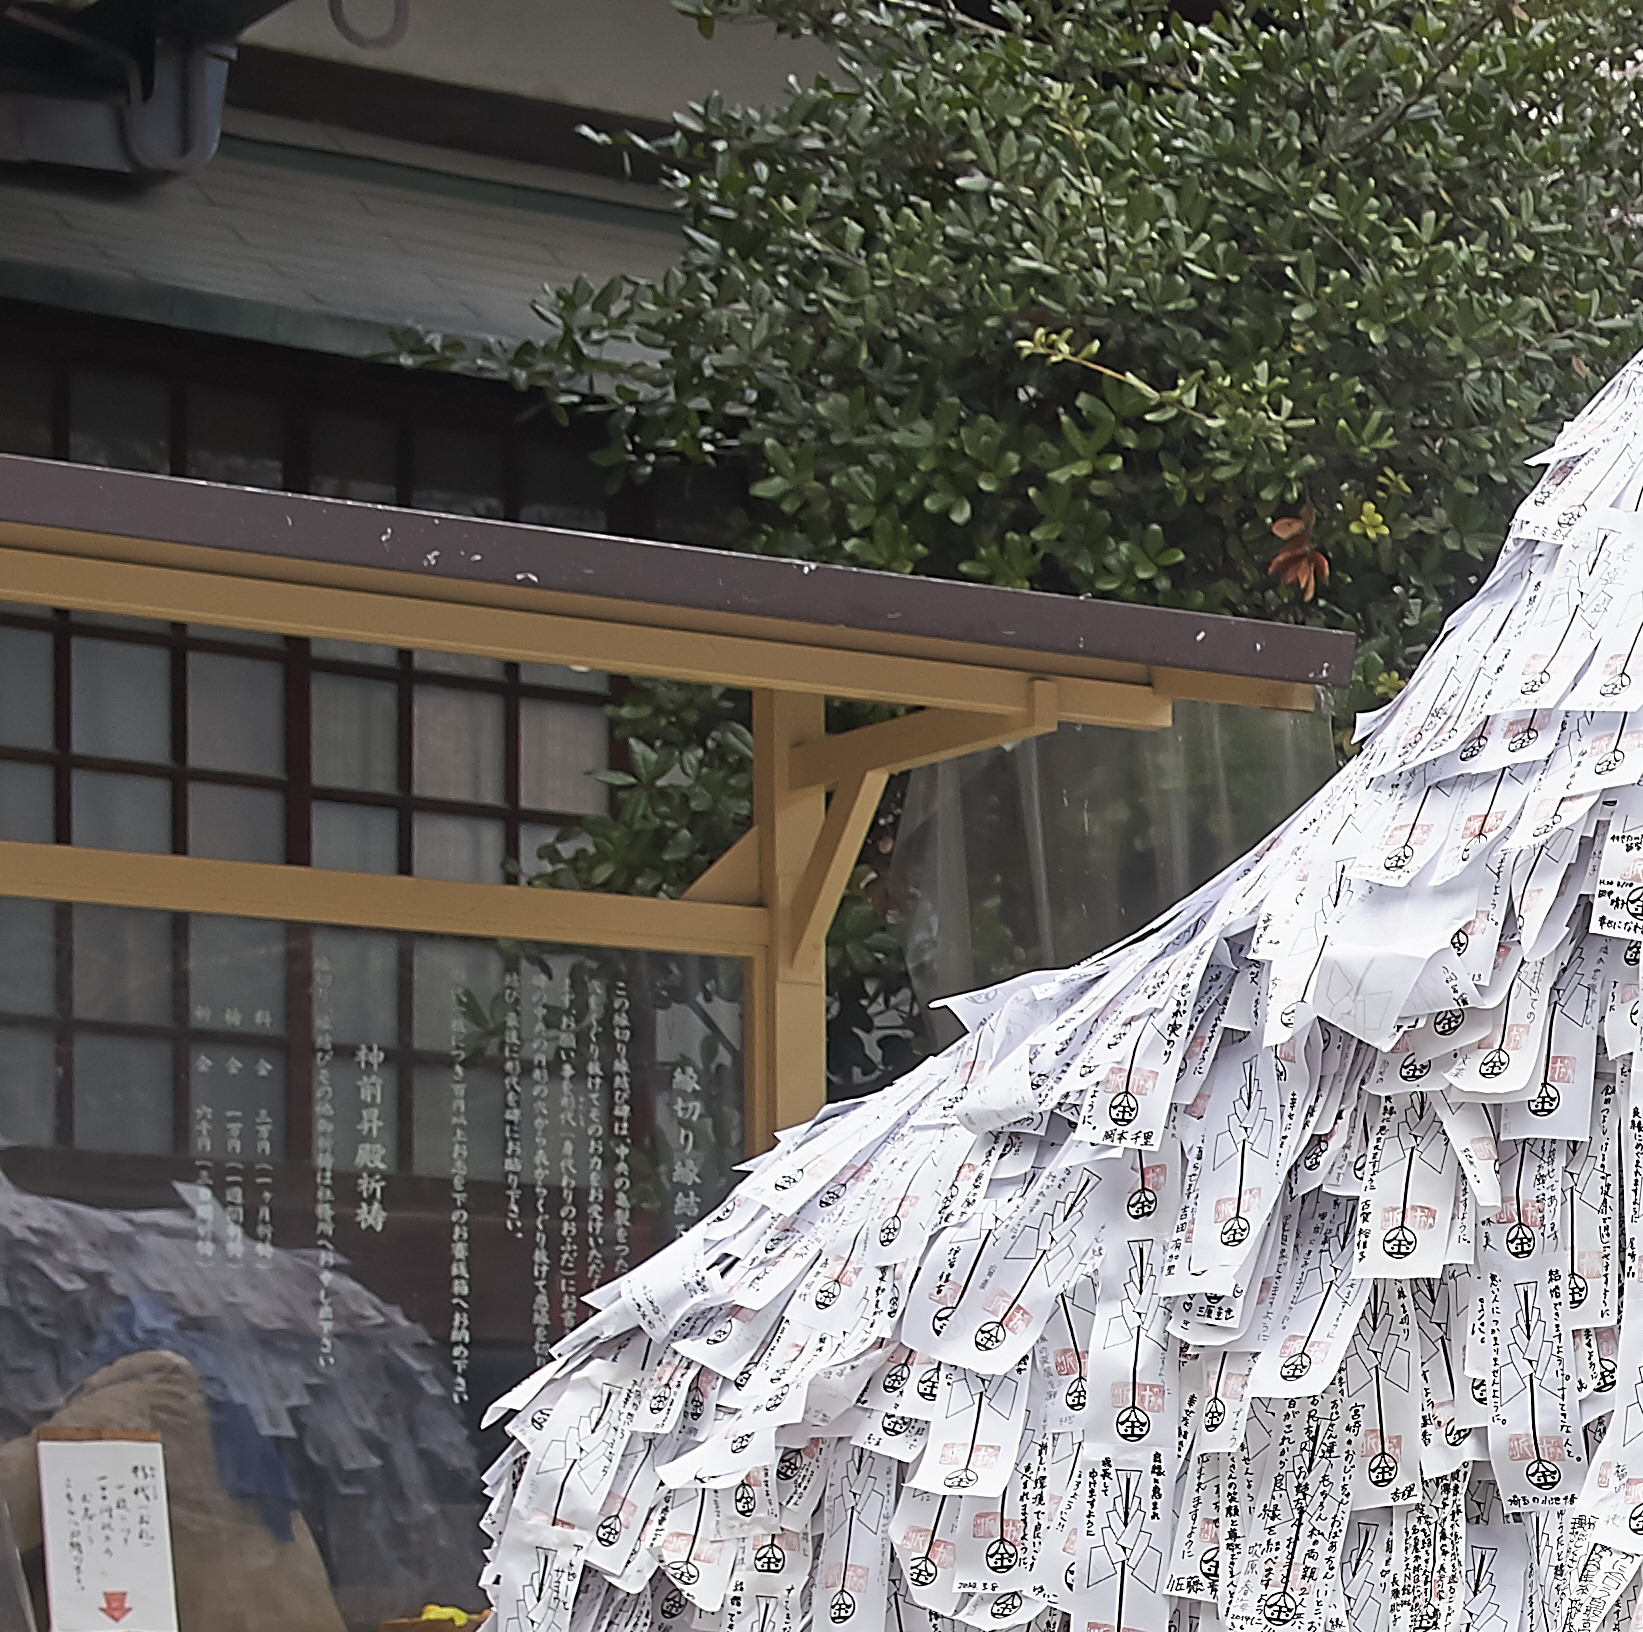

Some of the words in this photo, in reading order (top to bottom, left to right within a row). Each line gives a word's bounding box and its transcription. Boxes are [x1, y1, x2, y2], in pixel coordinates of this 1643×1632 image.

[354, 1044, 390, 1234] 神前昇殿祈祷
